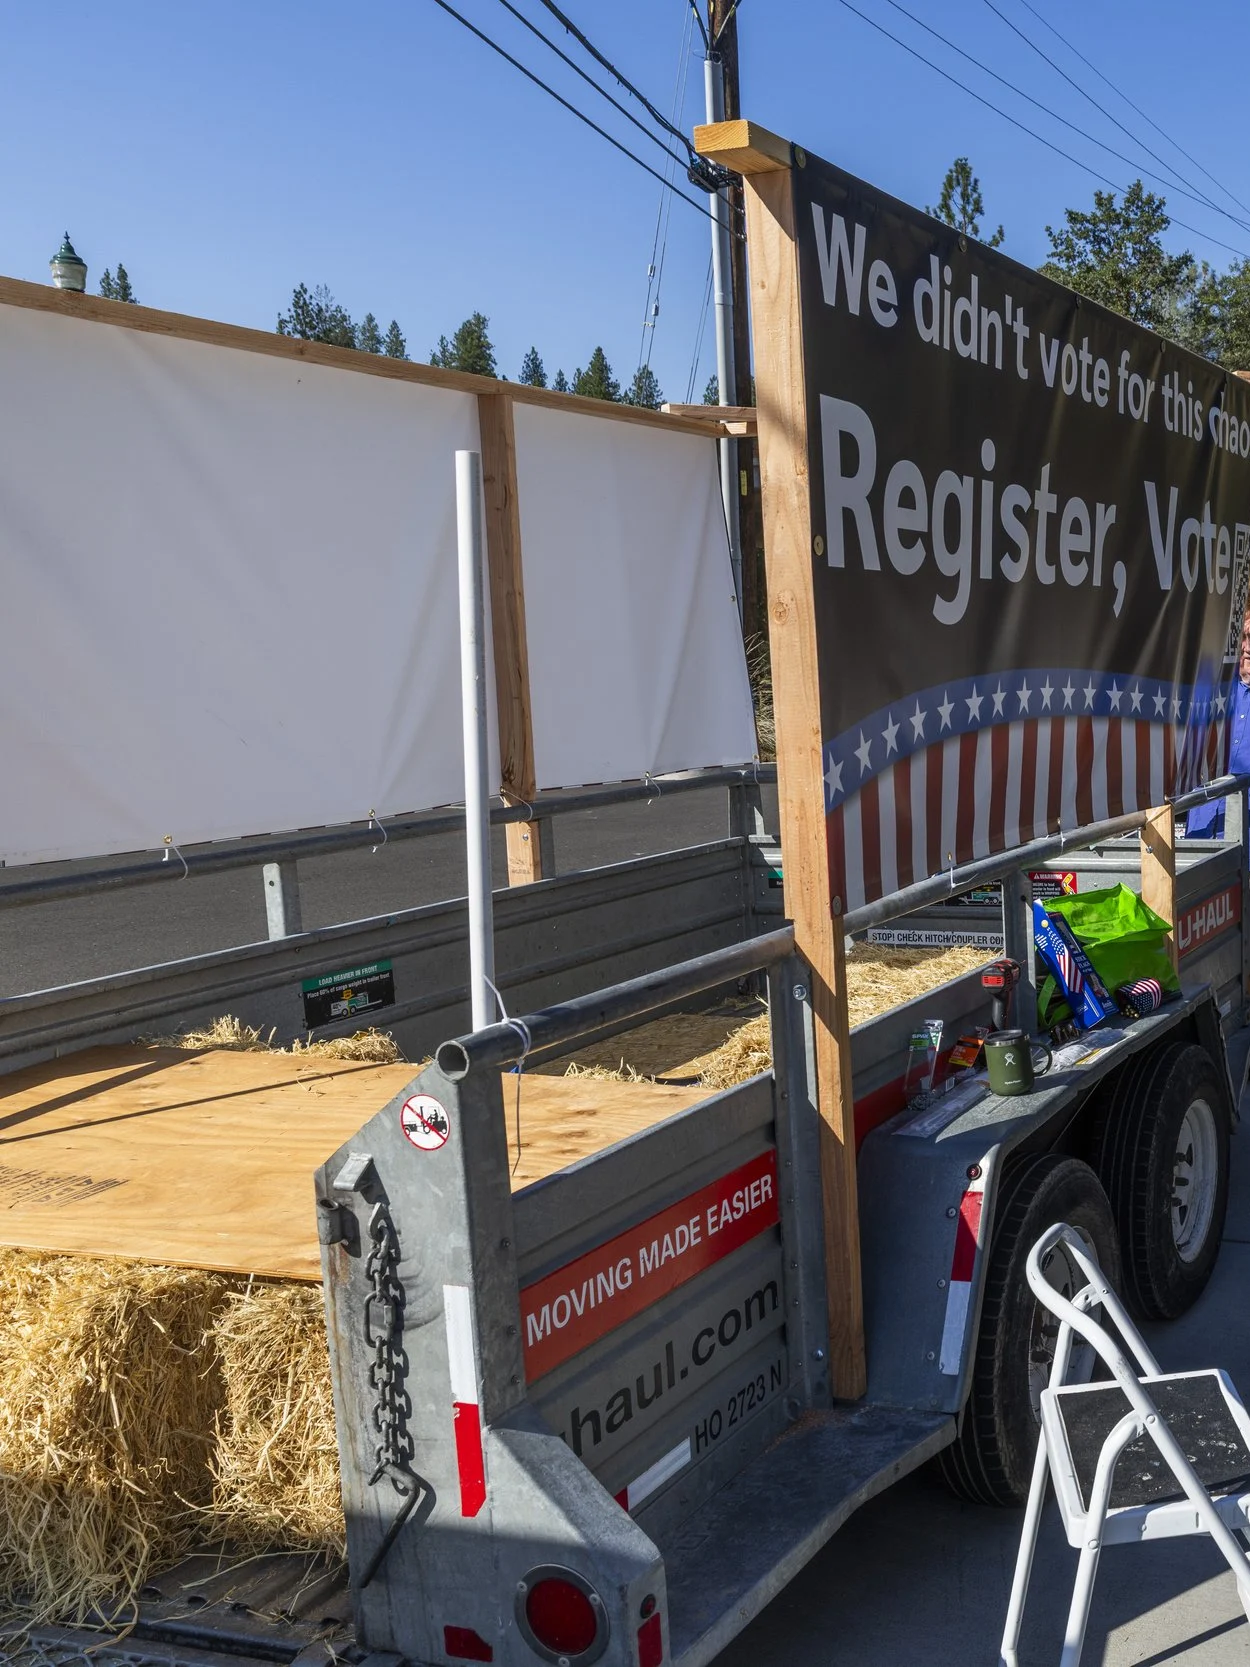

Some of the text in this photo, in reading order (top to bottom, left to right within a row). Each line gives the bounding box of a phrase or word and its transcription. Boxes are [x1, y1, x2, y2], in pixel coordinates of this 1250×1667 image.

[811, 201, 898, 328] We
[912, 255, 1029, 382] didn't
[1039, 332, 1110, 408] vote
[1118, 350, 1156, 423] for
[1162, 373, 1204, 442] this
[819, 394, 1232, 625] Register, Vote
[872, 932, 895, 942] STOP!
[896, 932, 924, 942] CHECK
[925, 934, 988, 945] HITCH/COUPLER
[1178, 892, 1233, 950] U-HAUL
[307, 991, 319, 999] Place
[336, 984, 348, 992] cargo
[348, 980, 363, 989] weight
[318, 965, 378, 986] LOAD HEAVIER IN FRONT
[526, 1173, 773, 1347] MOVING MADE EASIER
[558, 1279, 779, 1458] haul.com
[695, 1359, 781, 1454] HO 2723 N
